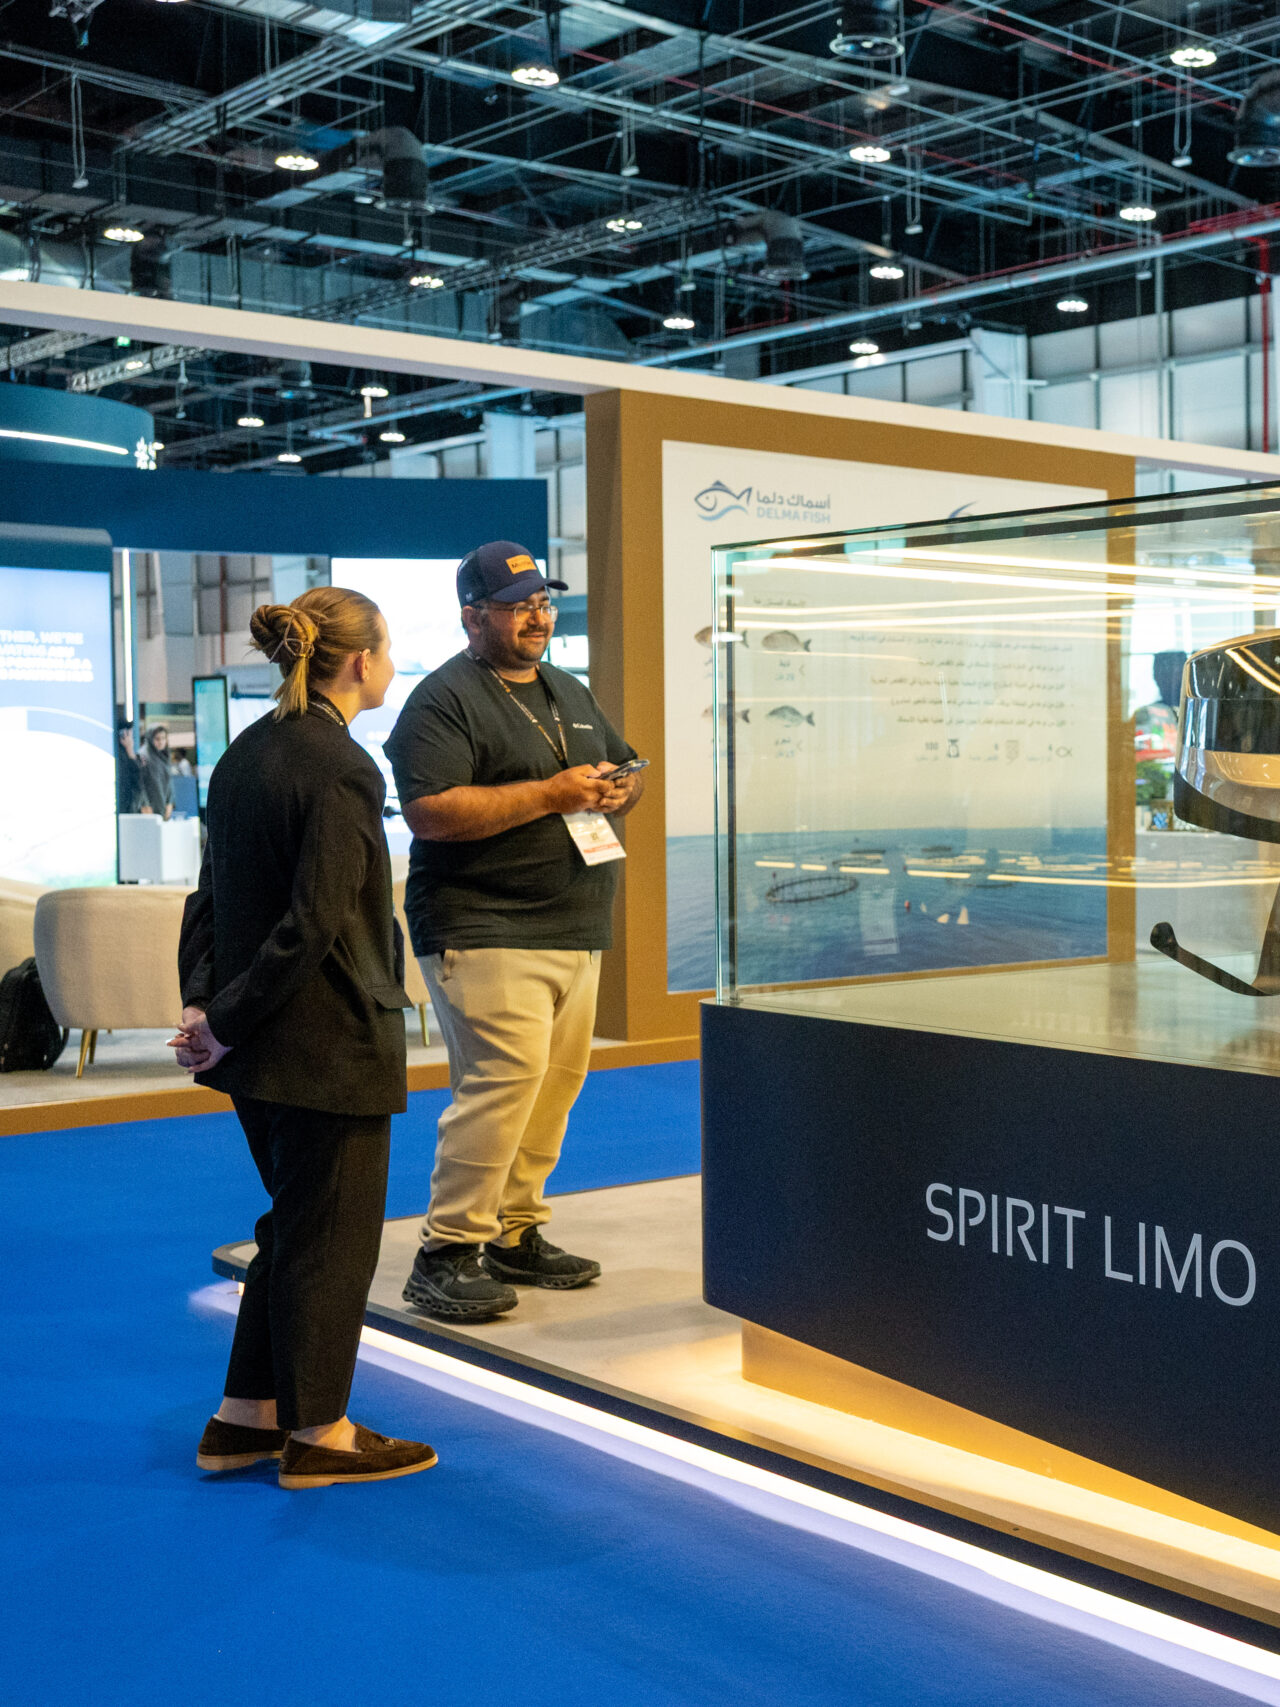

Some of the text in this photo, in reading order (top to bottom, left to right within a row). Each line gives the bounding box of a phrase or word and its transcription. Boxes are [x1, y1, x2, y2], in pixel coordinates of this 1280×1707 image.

[756, 506, 831, 524] DELMA FISH
[925, 1182, 1256, 1306] SPIRIT LIMO
